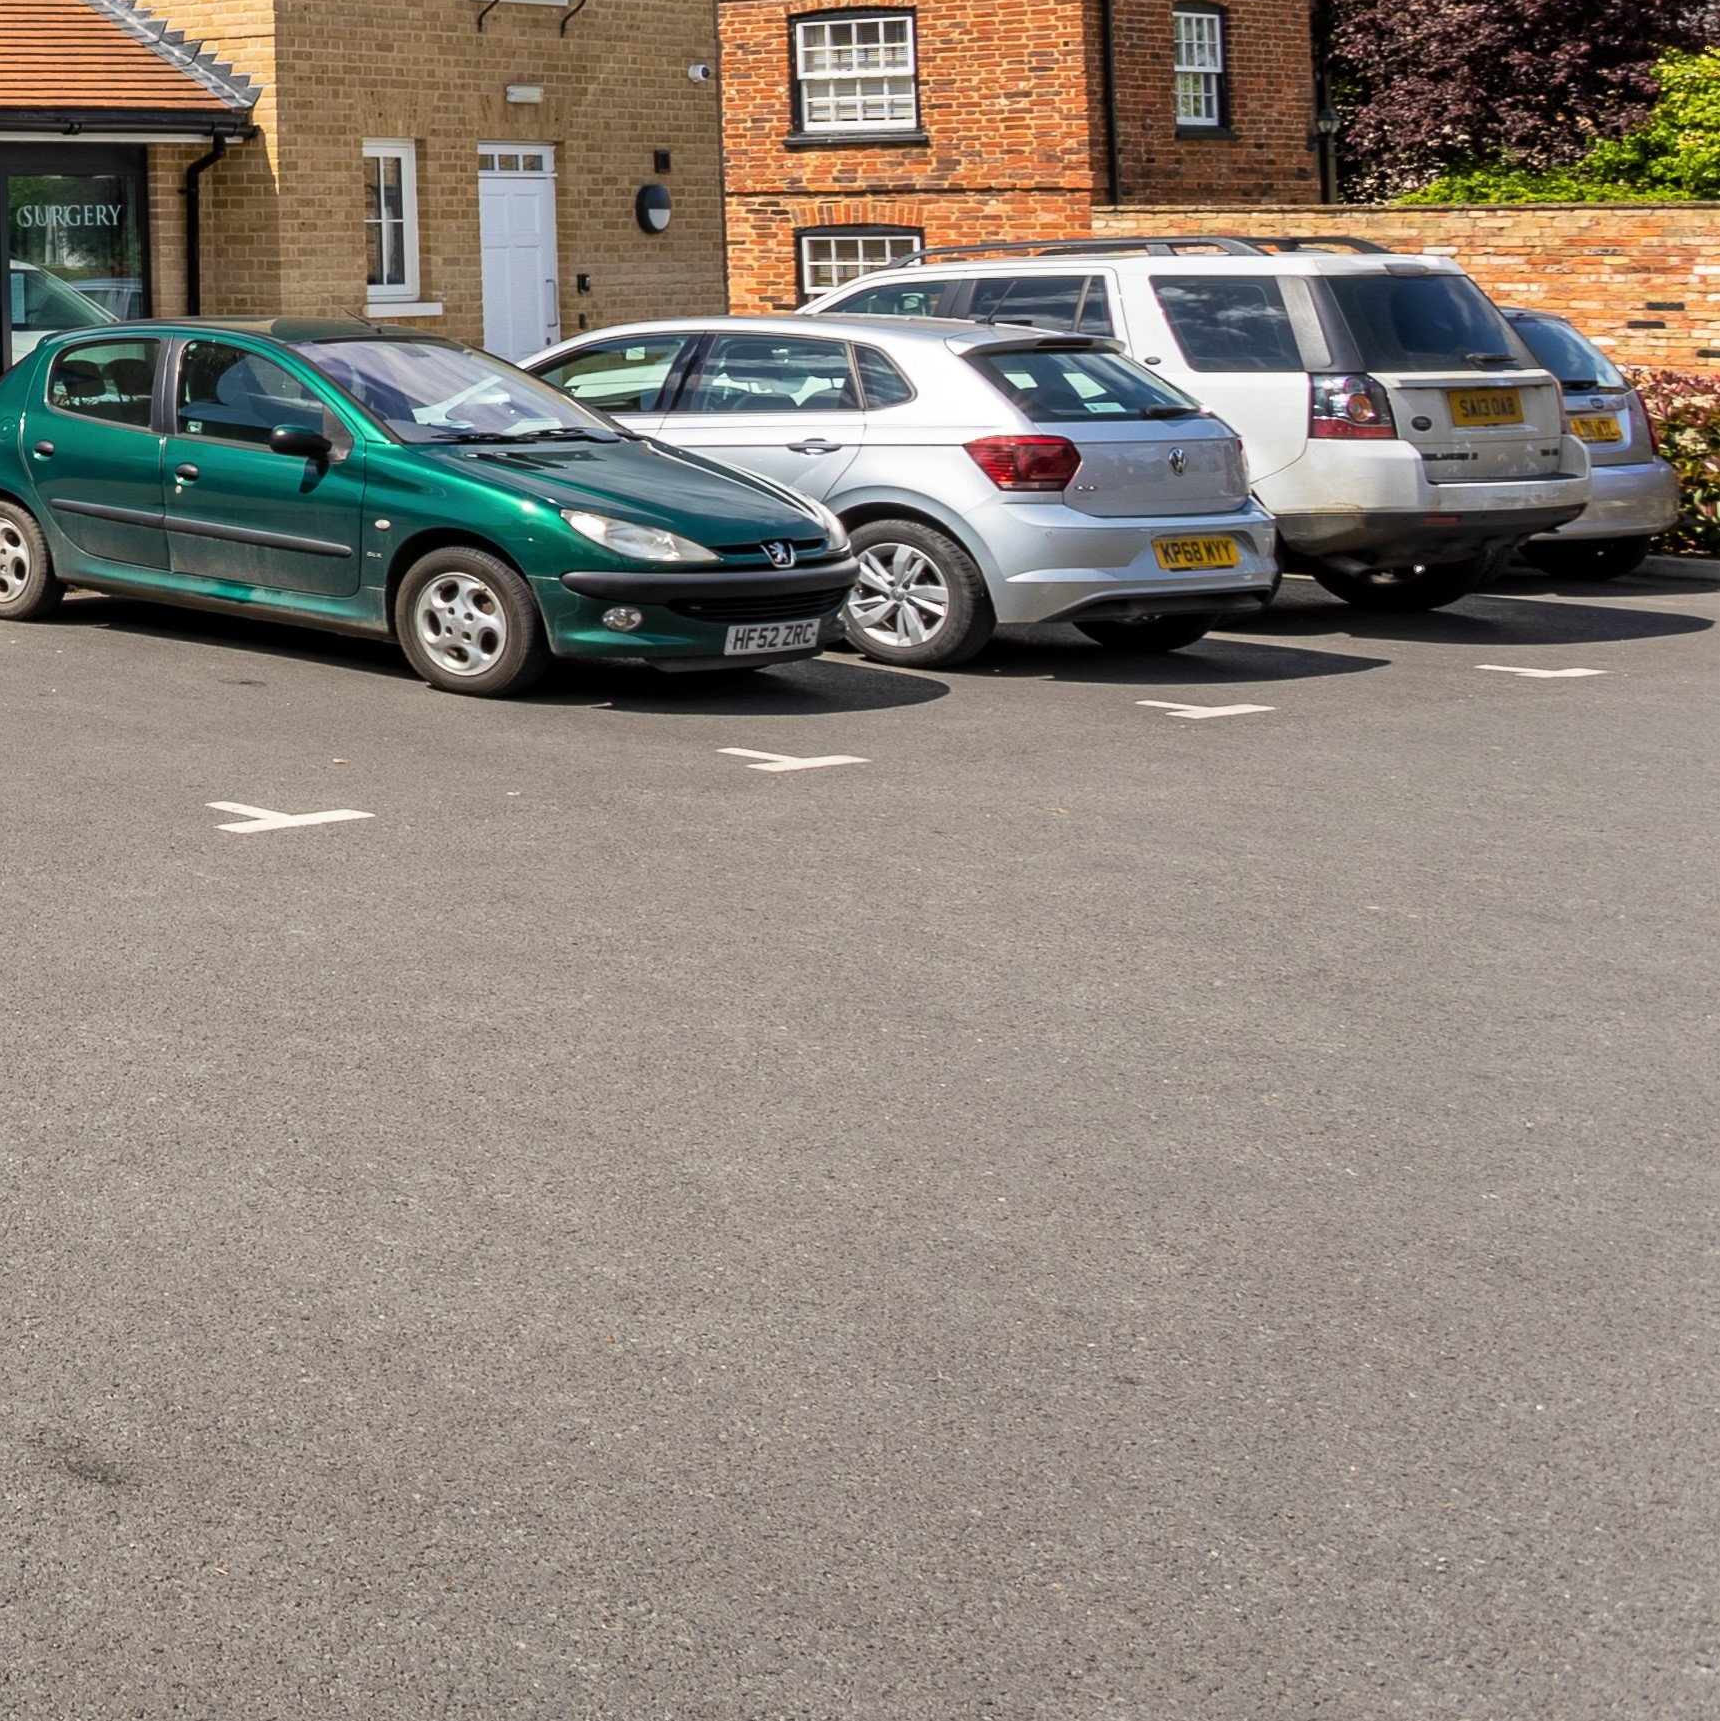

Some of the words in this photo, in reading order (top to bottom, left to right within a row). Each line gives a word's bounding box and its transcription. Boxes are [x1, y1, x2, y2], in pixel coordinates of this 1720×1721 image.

[23, 204, 122, 228] SURGERY
[1160, 541, 1204, 564] KP68
[733, 626, 780, 651] HF52
[781, 623, 814, 647] ZRC
